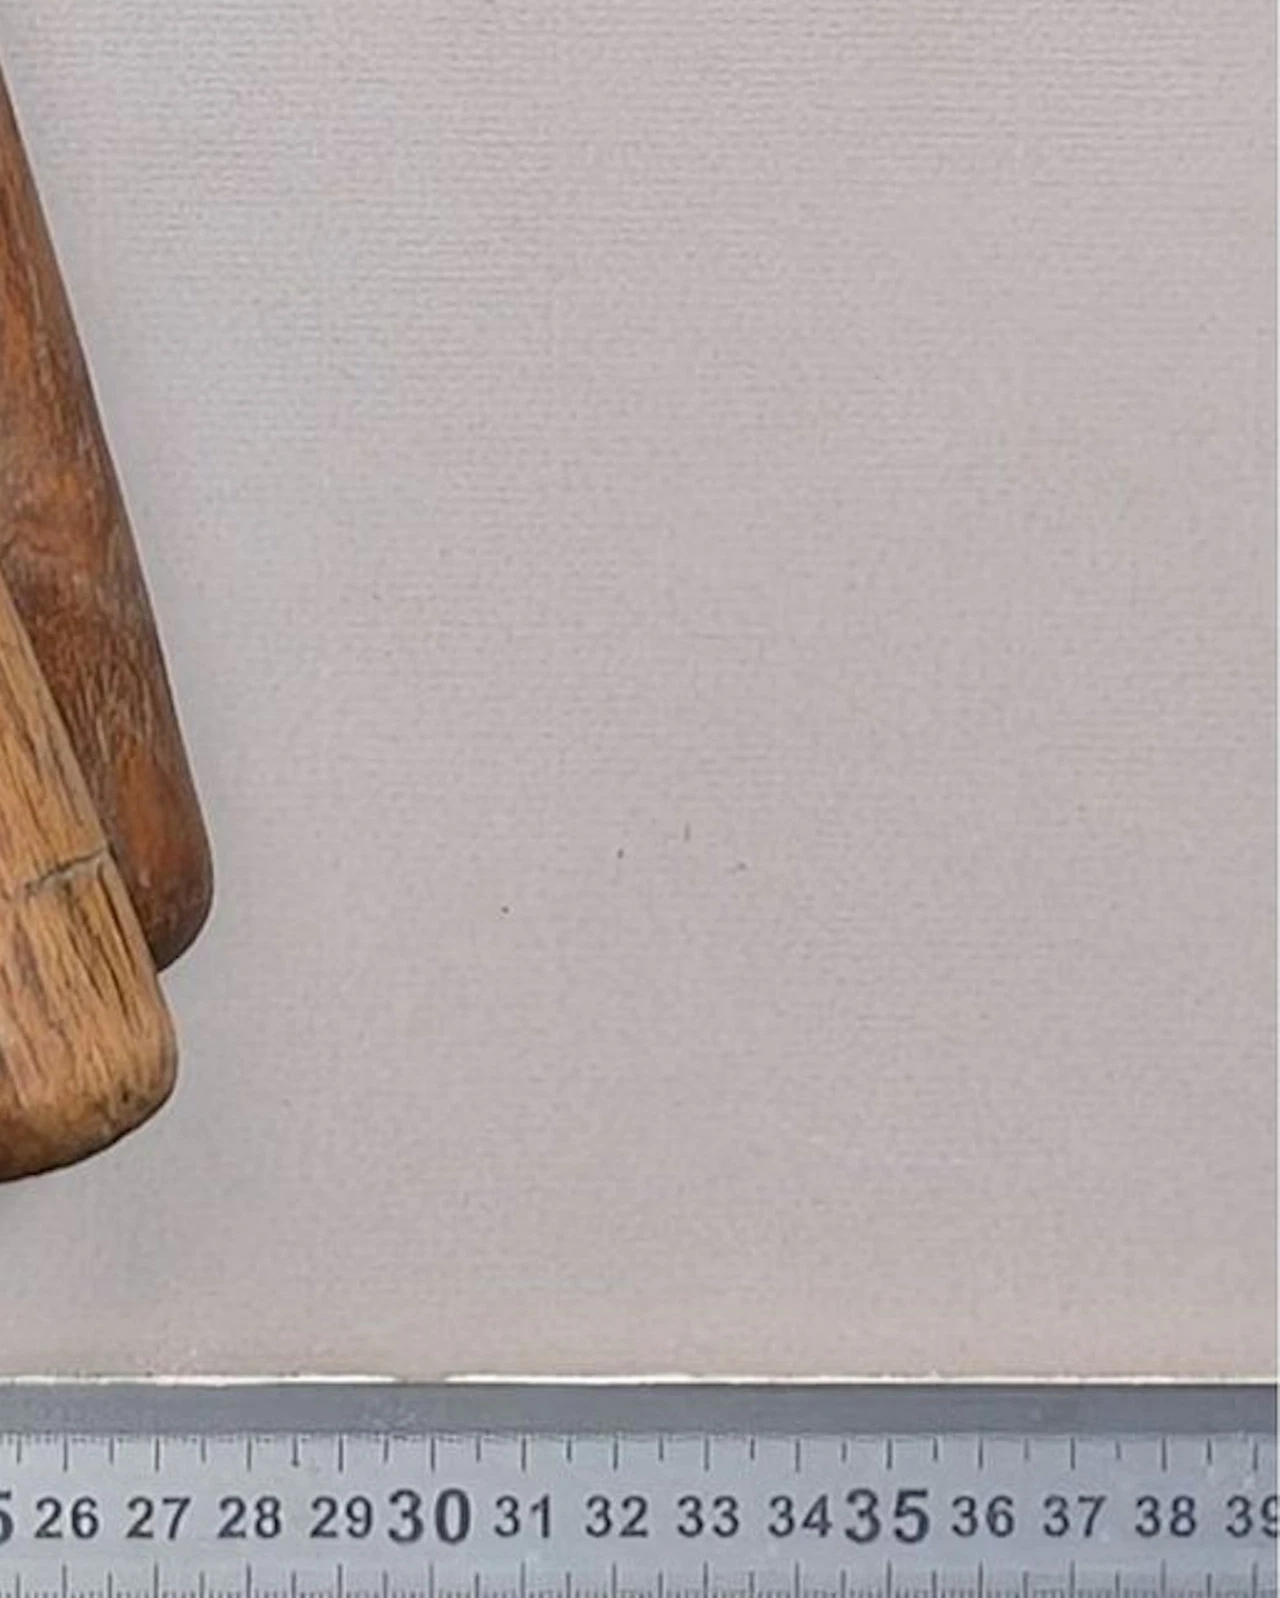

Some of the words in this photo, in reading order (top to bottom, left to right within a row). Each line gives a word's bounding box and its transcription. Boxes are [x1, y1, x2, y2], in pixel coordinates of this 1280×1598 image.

[34, 1496, 99, 1540] 26
[125, 1496, 191, 1541] 27
[217, 1495, 282, 1540] 28
[309, 1495, 373, 1539] 29
[387, 1488, 471, 1546] 30
[494, 1494, 550, 1539] 31
[585, 1495, 649, 1539] 32
[677, 1495, 740, 1539] 33
[768, 1494, 833, 1539] 34
[844, 1488, 930, 1545] 35
[951, 1495, 1015, 1539] 36
[1043, 1494, 1107, 1539] 37
[1134, 1495, 1197, 1539] 38
[1225, 1493, 1279, 1540] 39
